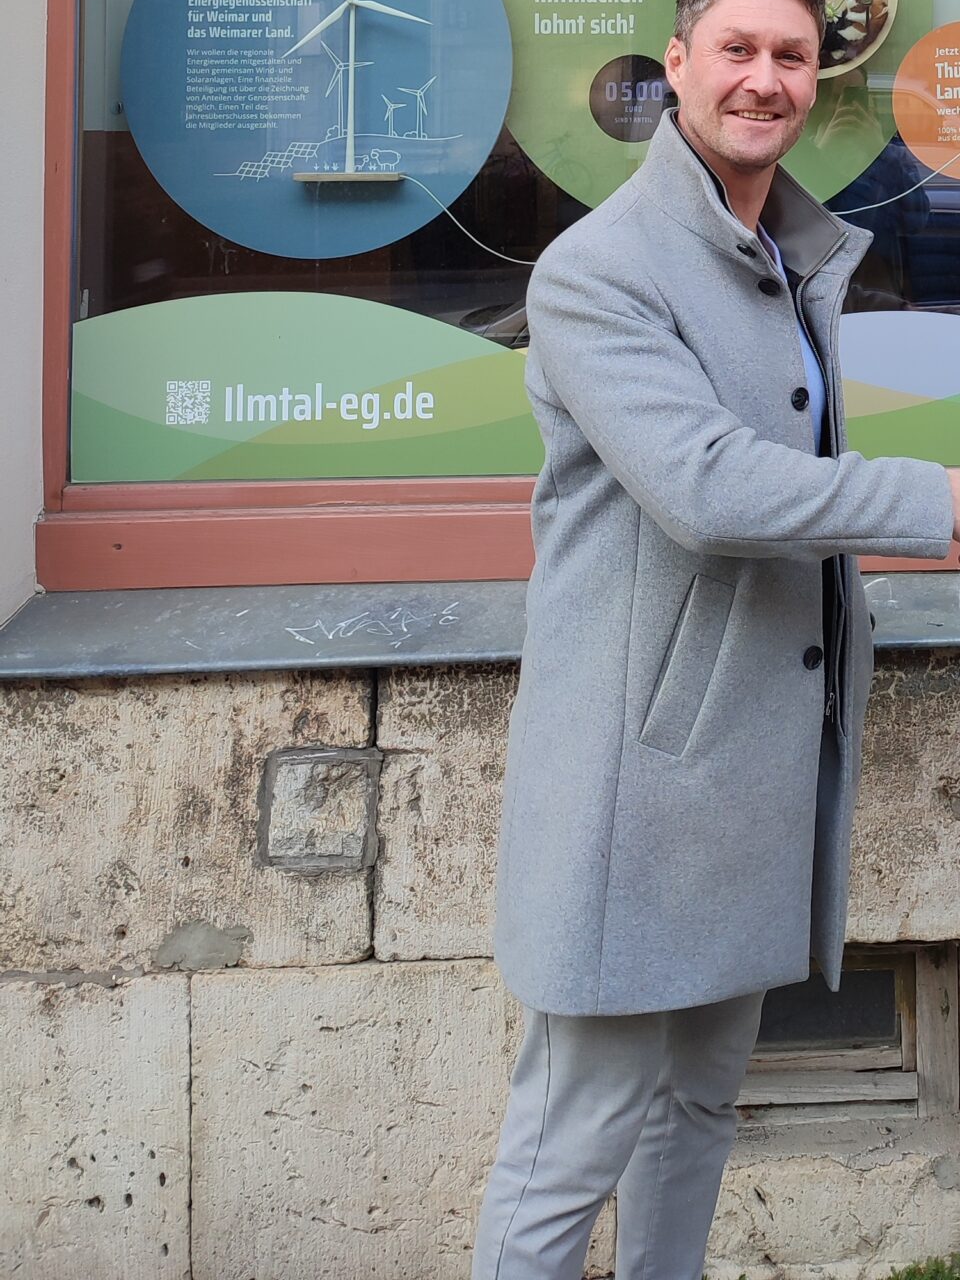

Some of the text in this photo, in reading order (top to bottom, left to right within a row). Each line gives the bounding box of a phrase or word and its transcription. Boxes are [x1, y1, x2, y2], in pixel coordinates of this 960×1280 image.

[187, 10, 272, 22] für Weimar und
[534, 13, 636, 35] lohnt sich!
[187, 26, 294, 38] das Weimarer Land.
[240, 49, 274, 57] regionale
[935, 47, 960, 58] Jetzt
[186, 59, 239, 67] Energiewende
[240, 58, 286, 66] mitgestalten
[211, 67, 254, 76] gemeinsam
[186, 86, 227, 94] Beteiligung
[239, 85, 259, 93] über
[271, 85, 310, 94] Zeichnung
[186, 103, 217, 112] möglich.
[218, 103, 239, 111] Einen
[240, 103, 254, 111] Teil
[185, 112, 261, 121] Jahresüberschusses
[198, 121, 236, 131] Mitglieder
[237, 121, 279, 130] ausgezahlt.
[225, 382, 435, 429] Ilmtal-eg.de
